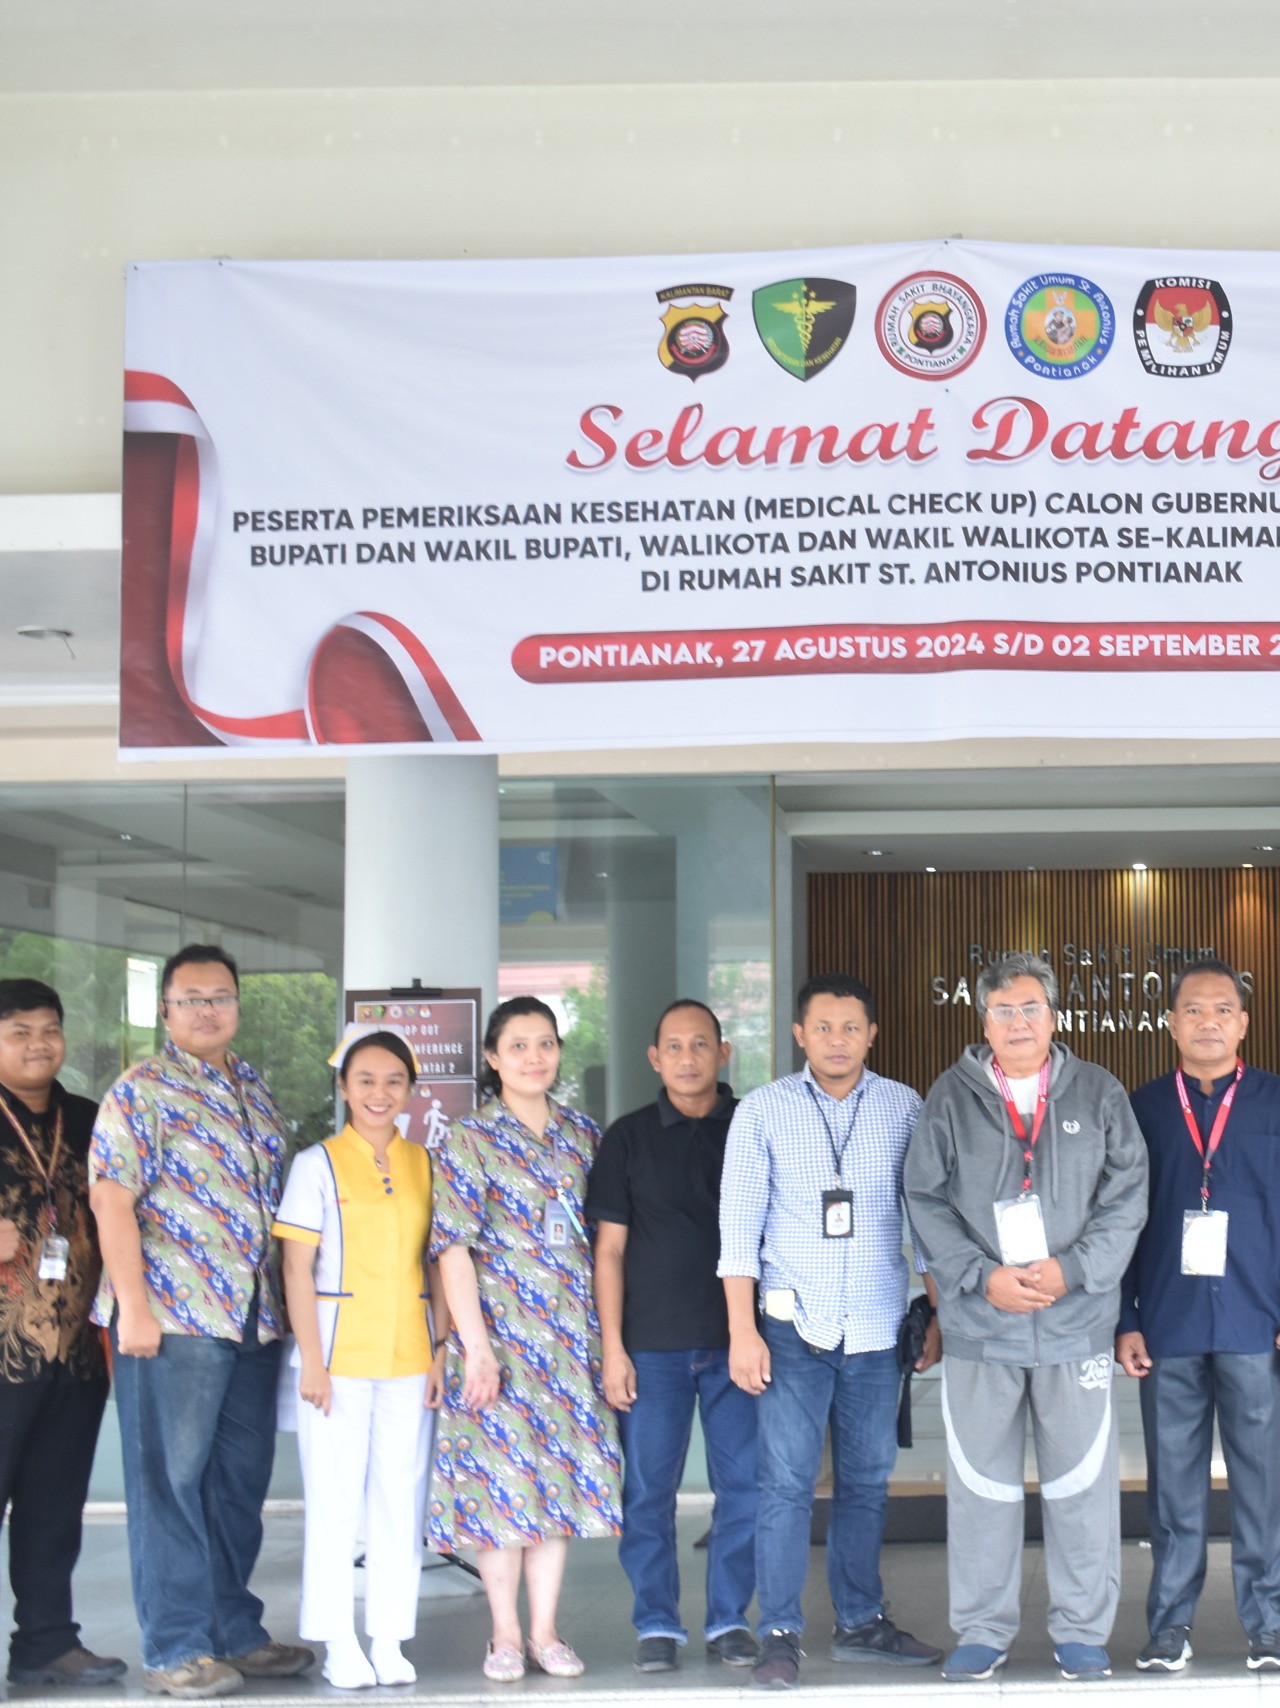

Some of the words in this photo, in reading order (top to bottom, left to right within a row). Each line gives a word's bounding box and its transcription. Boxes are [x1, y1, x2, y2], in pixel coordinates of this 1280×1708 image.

[660, 286, 705, 300] KALIMANTAN
[706, 287, 730, 299] BARAT
[1038, 275, 1075, 286] Umum
[1154, 278, 1211, 290] KOMISI
[1012, 280, 1038, 308] Sakit
[887, 305, 900, 347] RUMAH
[898, 283, 926, 303] SAKIT
[931, 283, 975, 345] BHAYANGKARA
[1007, 308, 1022, 349] Rumah
[904, 354, 959, 368] PONTIANAK
[1136, 329, 1201, 376] PEMILIHAN
[1205, 330, 1230, 373] UMUM
[1024, 355, 1098, 378] Pontianak
[566, 404, 936, 468] Selamat
[233, 509, 354, 532] PESERTA
[362, 503, 562, 529] PEMERIKSAAN
[571, 499, 735, 524] KESEHATAN
[744, 494, 881, 523] (MEDICAL
[887, 491, 983, 515] CHECK
[991, 490, 1037, 518] UP)
[1045, 492, 1143, 515] CALON
[250, 543, 347, 567] BUPATI
[356, 541, 416, 564] DAN
[424, 539, 517, 562] WAKIL
[525, 536, 631, 562] BUPATI,
[639, 532, 790, 557] WALIKOTA
[798, 529, 857, 553] DAN
[864, 527, 955, 550] WAKIL
[961, 525, 1110, 549] WALIKOTA
[641, 570, 670, 592] DI
[679, 567, 781, 591] RUMAH
[790, 562, 871, 587] SAKIT
[878, 563, 915, 585] ST.
[924, 559, 1068, 584] ANTONIUS
[1076, 561, 1243, 583] PONTIANAK
[539, 641, 724, 669] PONTIANAK,
[731, 639, 767, 663] 27
[773, 635, 908, 662] AGUSTUS
[915, 632, 986, 659] 2024
[993, 631, 1045, 657] S/D
[1051, 634, 1091, 657] 02
[1098, 633, 1262, 657] SEPTEMBER
[1064, 942, 1132, 967] Sakit
[421, 1025, 439, 1036] OUT
[1056, 1008, 1171, 1033] NTIANAK
[414, 1043, 463, 1054] NFERENCE
[449, 1062, 456, 1073] 2
